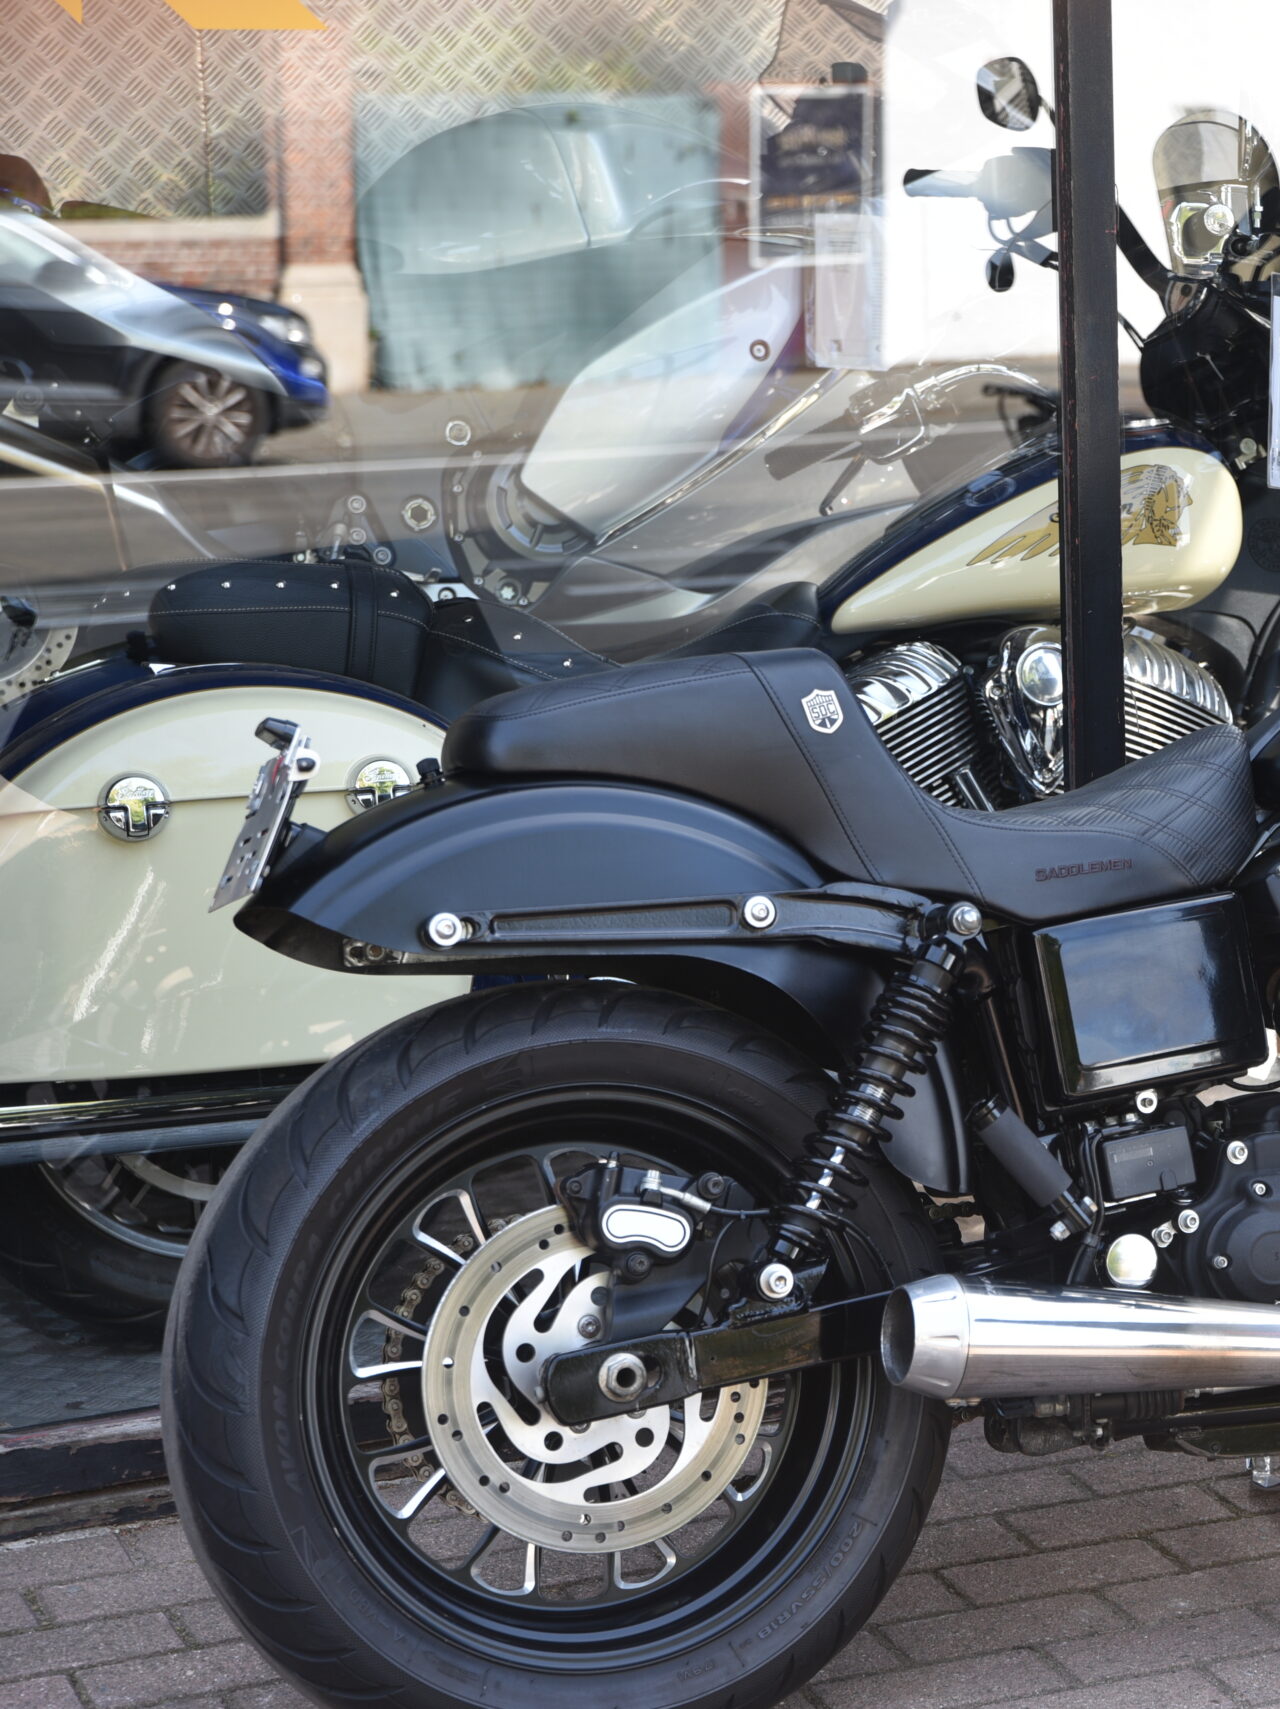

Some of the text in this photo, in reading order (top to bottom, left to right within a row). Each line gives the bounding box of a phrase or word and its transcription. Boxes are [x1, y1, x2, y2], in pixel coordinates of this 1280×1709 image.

[1035, 858, 1132, 882] SADDLEMEN
[276, 1232, 322, 1370] COBRA
[273, 1385, 305, 1495] AVON
